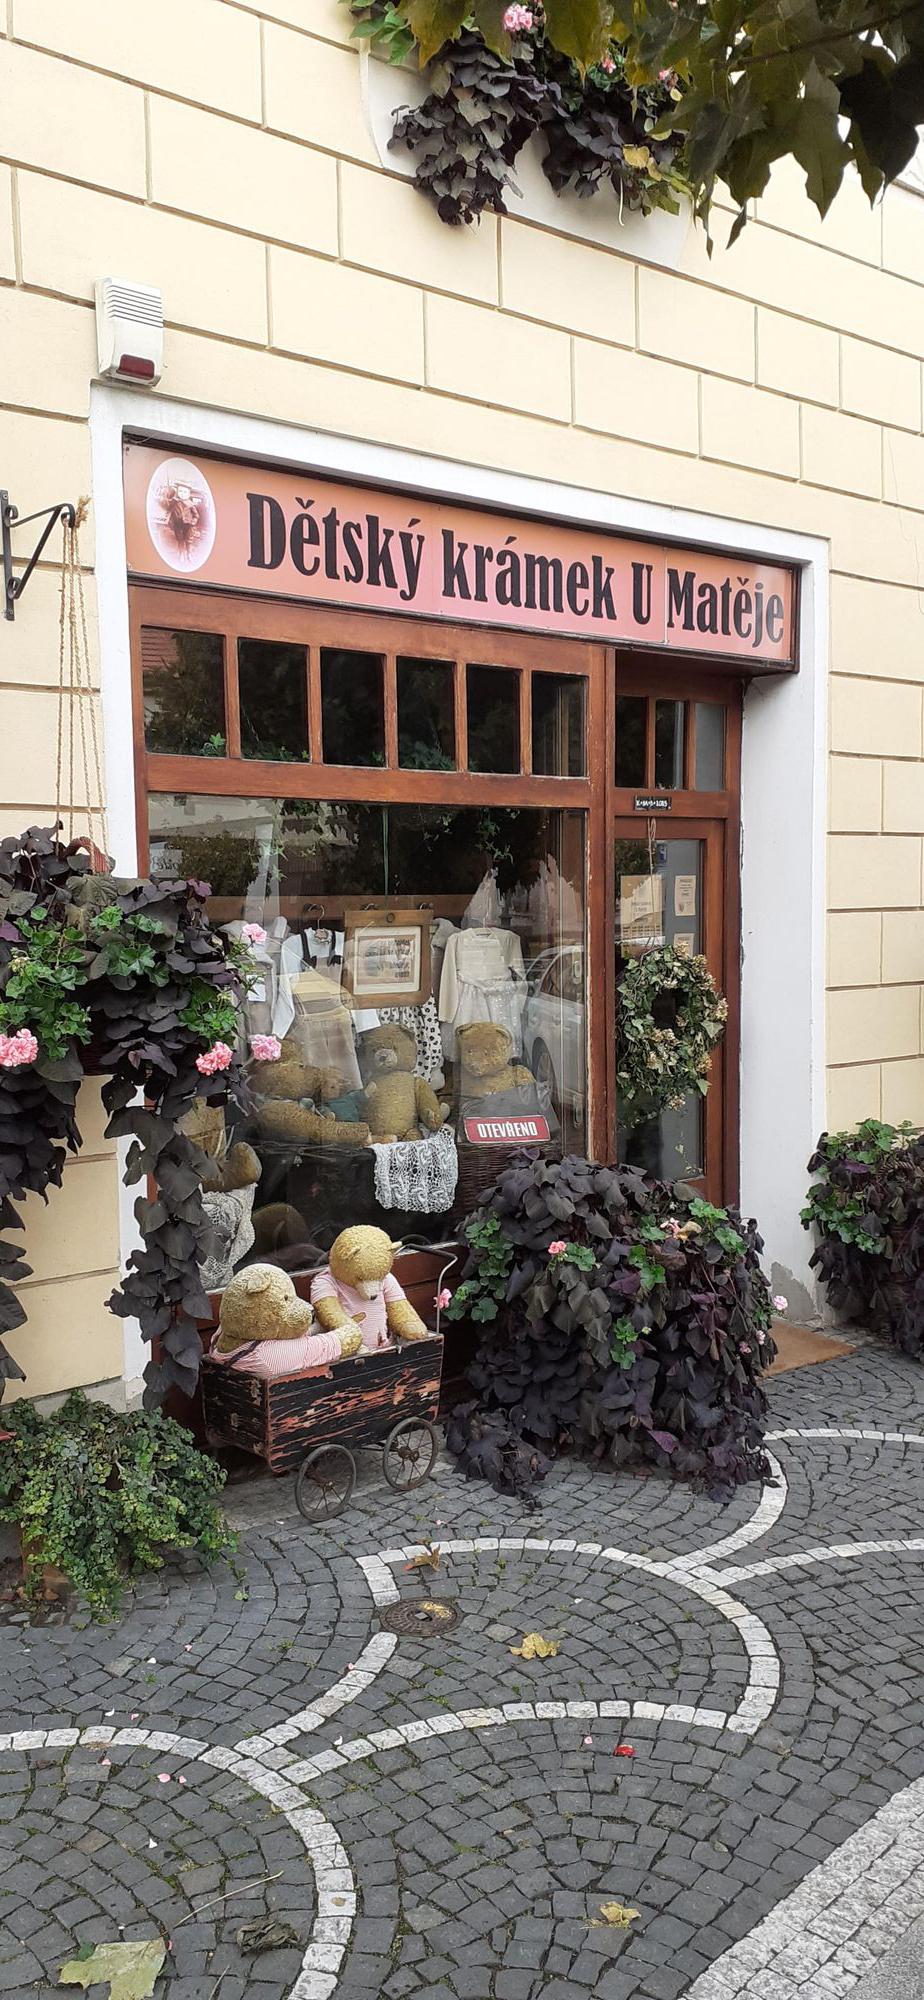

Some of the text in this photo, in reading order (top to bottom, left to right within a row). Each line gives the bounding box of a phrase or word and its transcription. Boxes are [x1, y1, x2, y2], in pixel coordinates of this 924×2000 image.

[246, 492, 784, 648] Dětský krámek U Matěje
[476, 1121, 538, 1138] OTEVŘENO
